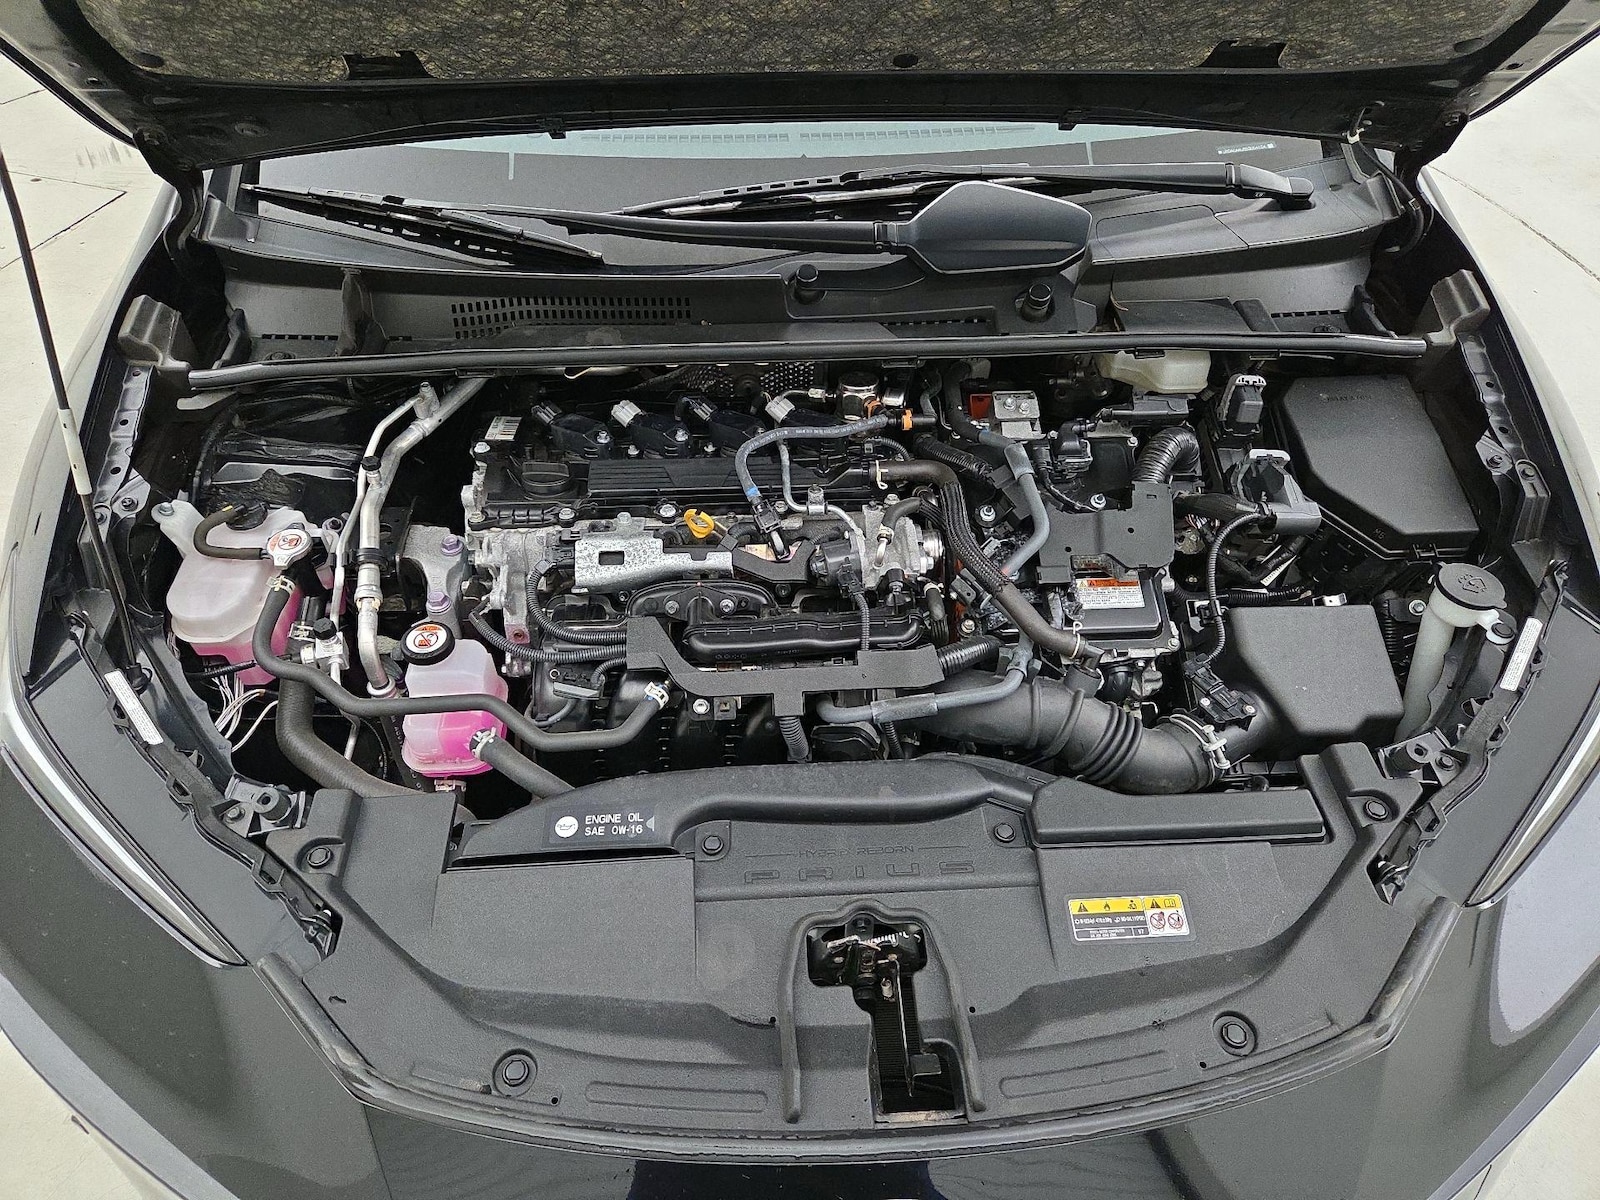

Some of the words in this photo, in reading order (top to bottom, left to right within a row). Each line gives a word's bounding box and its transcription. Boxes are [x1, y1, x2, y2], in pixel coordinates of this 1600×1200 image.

[585, 813, 621, 825] ENGINE
[628, 812, 644, 822] OIL
[585, 826, 605, 836] SAE
[611, 825, 643, 835] 0W-16
[856, 845, 914, 856] REBORN
[744, 860, 975, 884] PRIUS
